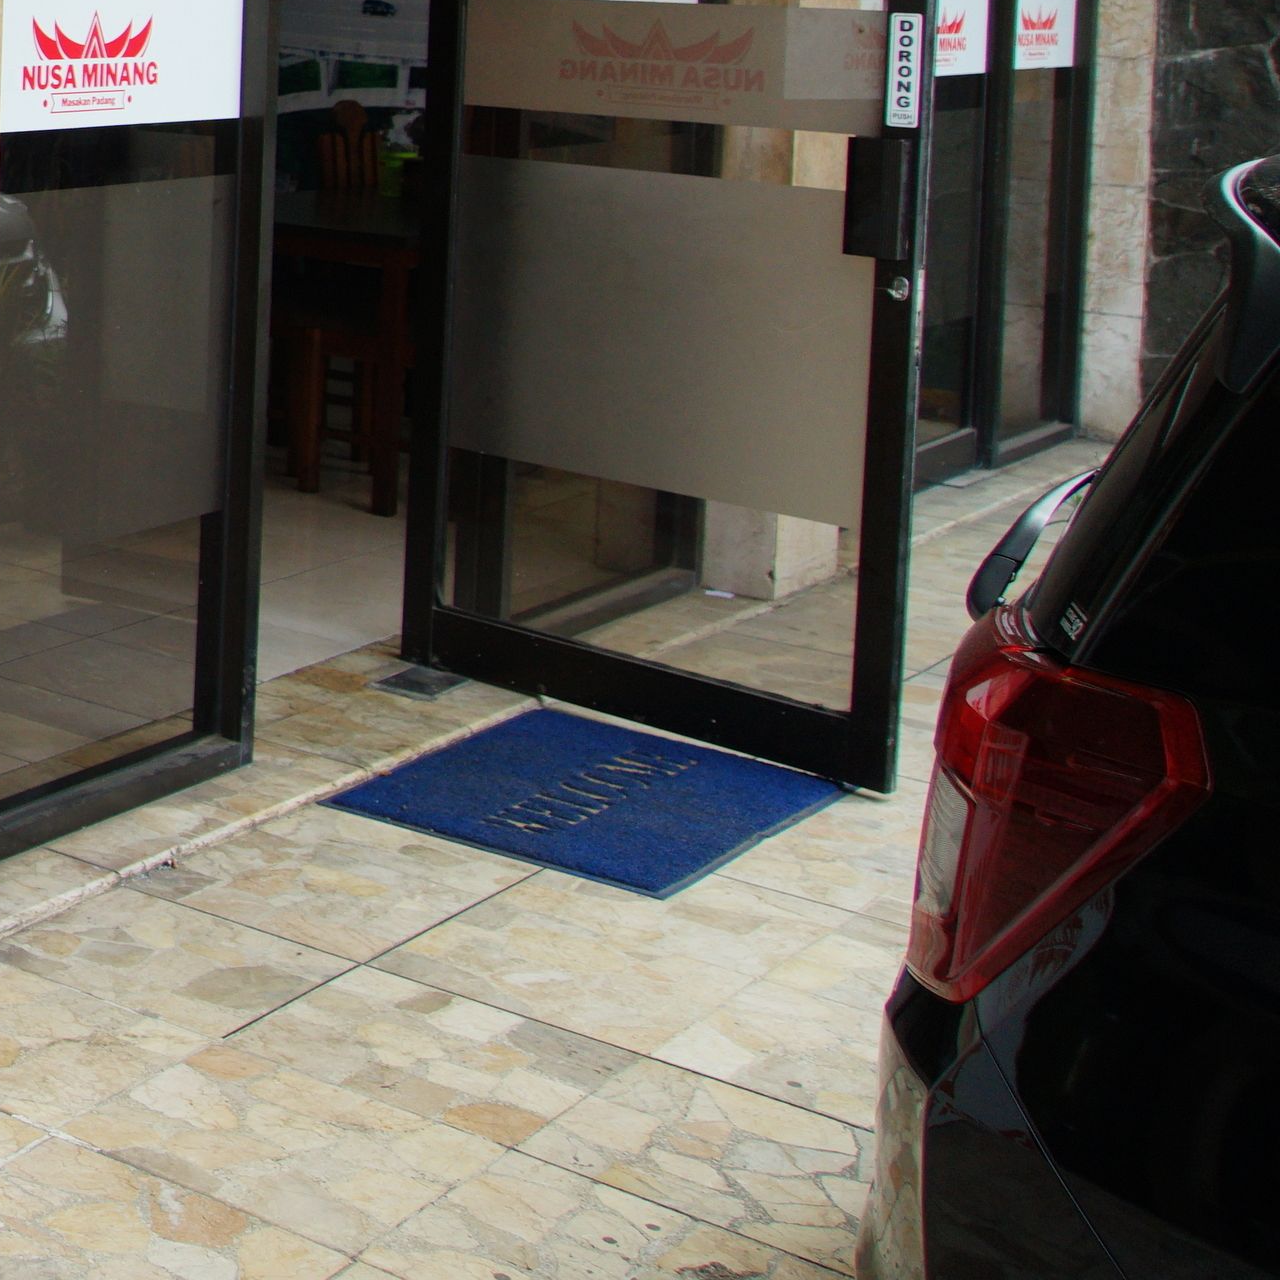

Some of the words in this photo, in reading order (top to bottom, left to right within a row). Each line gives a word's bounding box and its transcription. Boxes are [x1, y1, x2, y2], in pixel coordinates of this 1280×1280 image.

[939, 37, 967, 52] MINANG
[1035, 32, 1059, 47] MINANG
[896, 19, 915, 109] DORONG
[22, 64, 76, 91] NUSA
[82, 61, 159, 88] MINANG
[61, 97, 91, 107] Masakan
[92, 96, 116, 106] Padang
